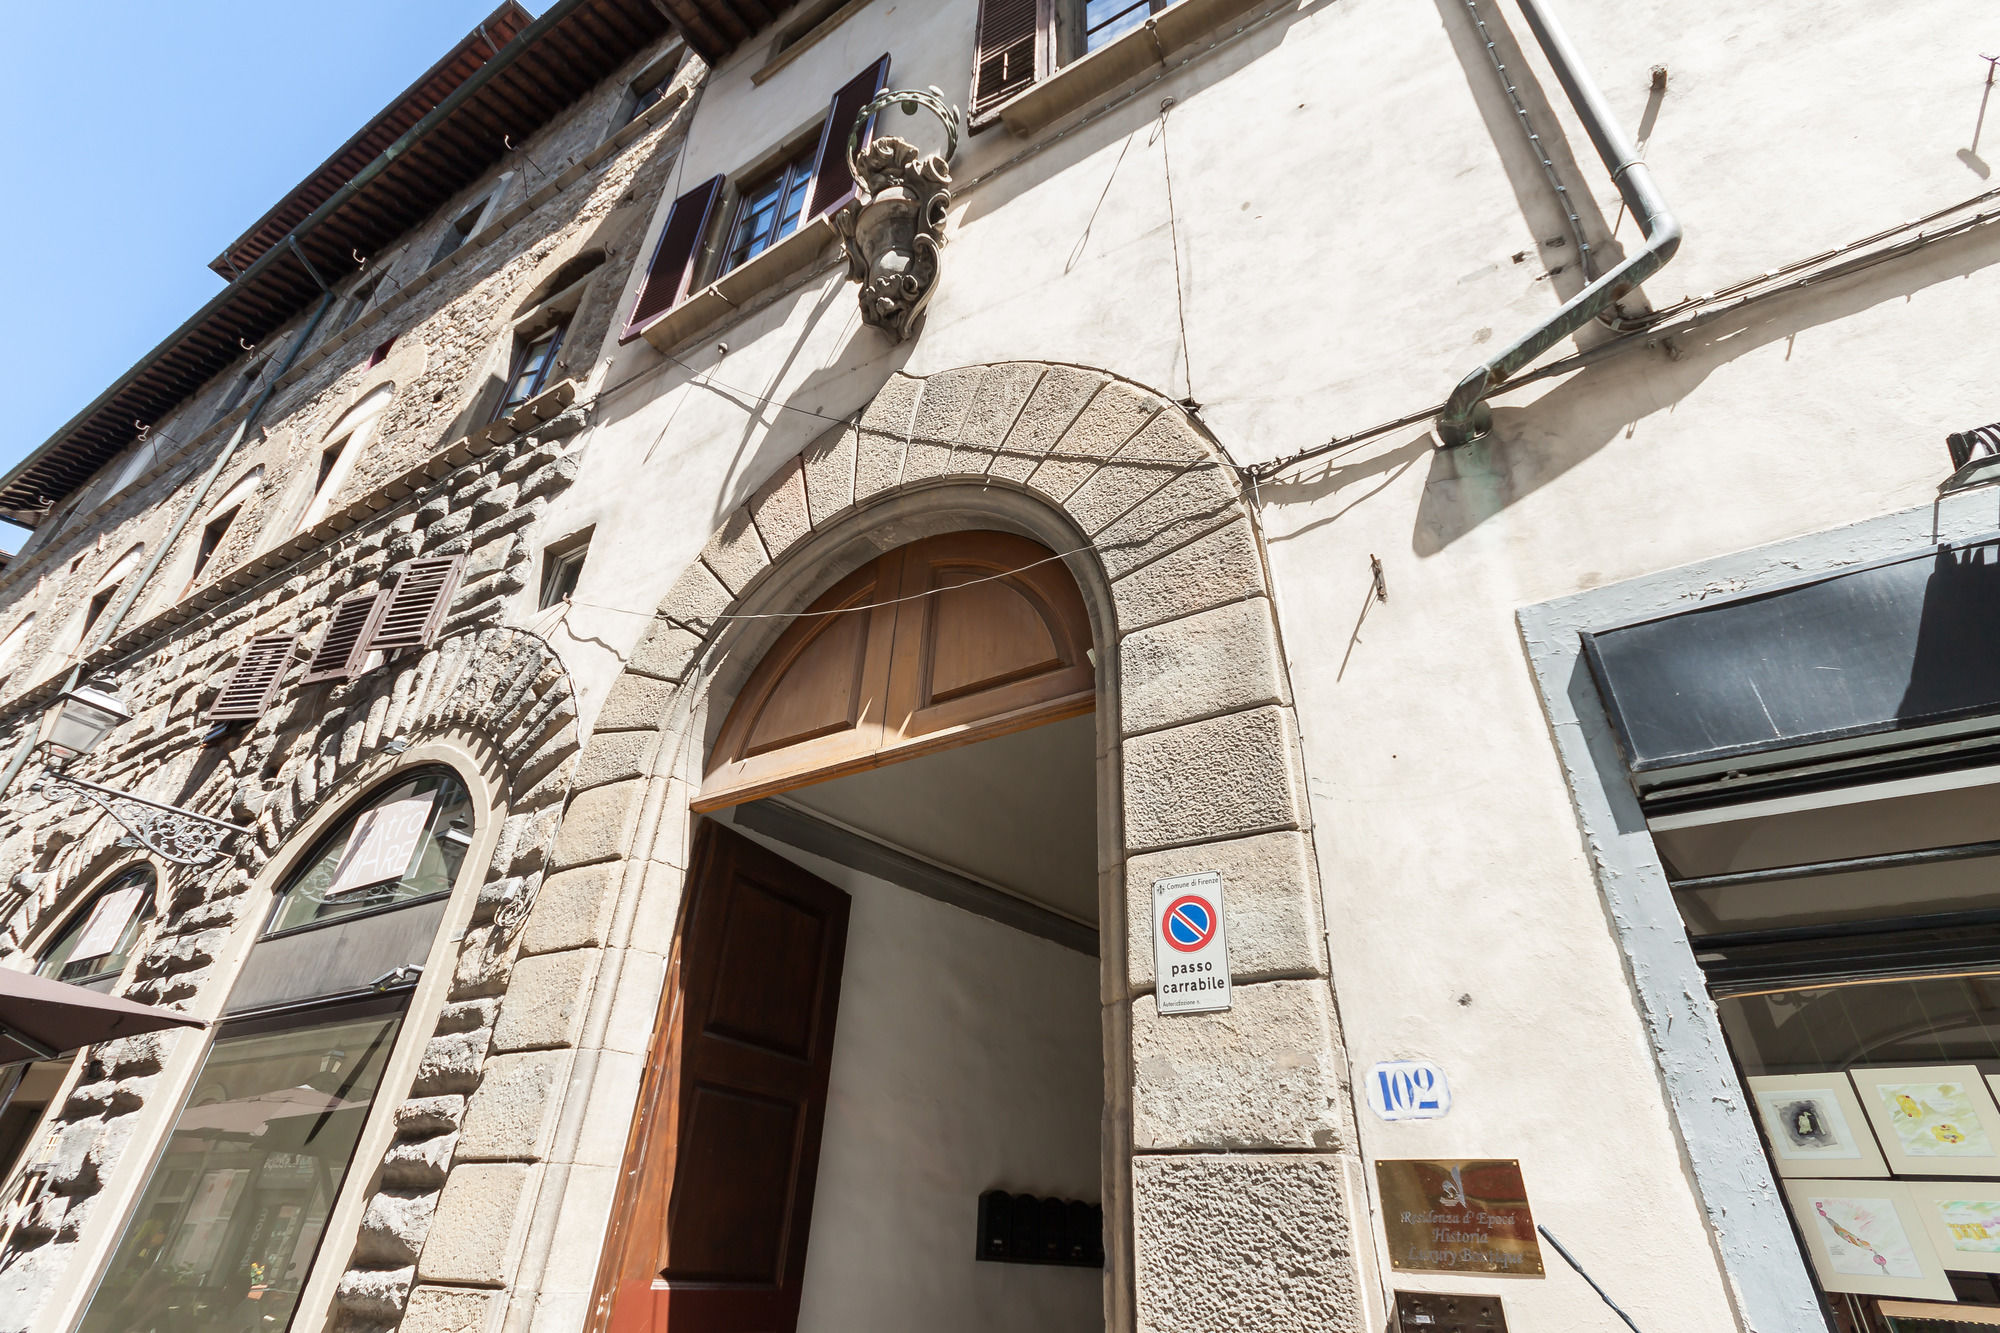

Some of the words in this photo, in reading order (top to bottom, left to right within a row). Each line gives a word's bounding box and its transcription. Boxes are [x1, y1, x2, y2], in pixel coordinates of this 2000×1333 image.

[1166, 881, 1189, 890] Comune
[1191, 878, 1197, 887] di
[1198, 877, 1219, 886] Firenze
[1172, 962, 1213, 977] passo
[1163, 977, 1225, 994] carrabile
[1378, 1068, 1440, 1112] 102
[1401, 1209, 1460, 1225] Residenza
[1432, 1228, 1489, 1244] Historia
[1408, 1246, 1457, 1267] Luxury
[1461, 1247, 1524, 1269] Boutique
